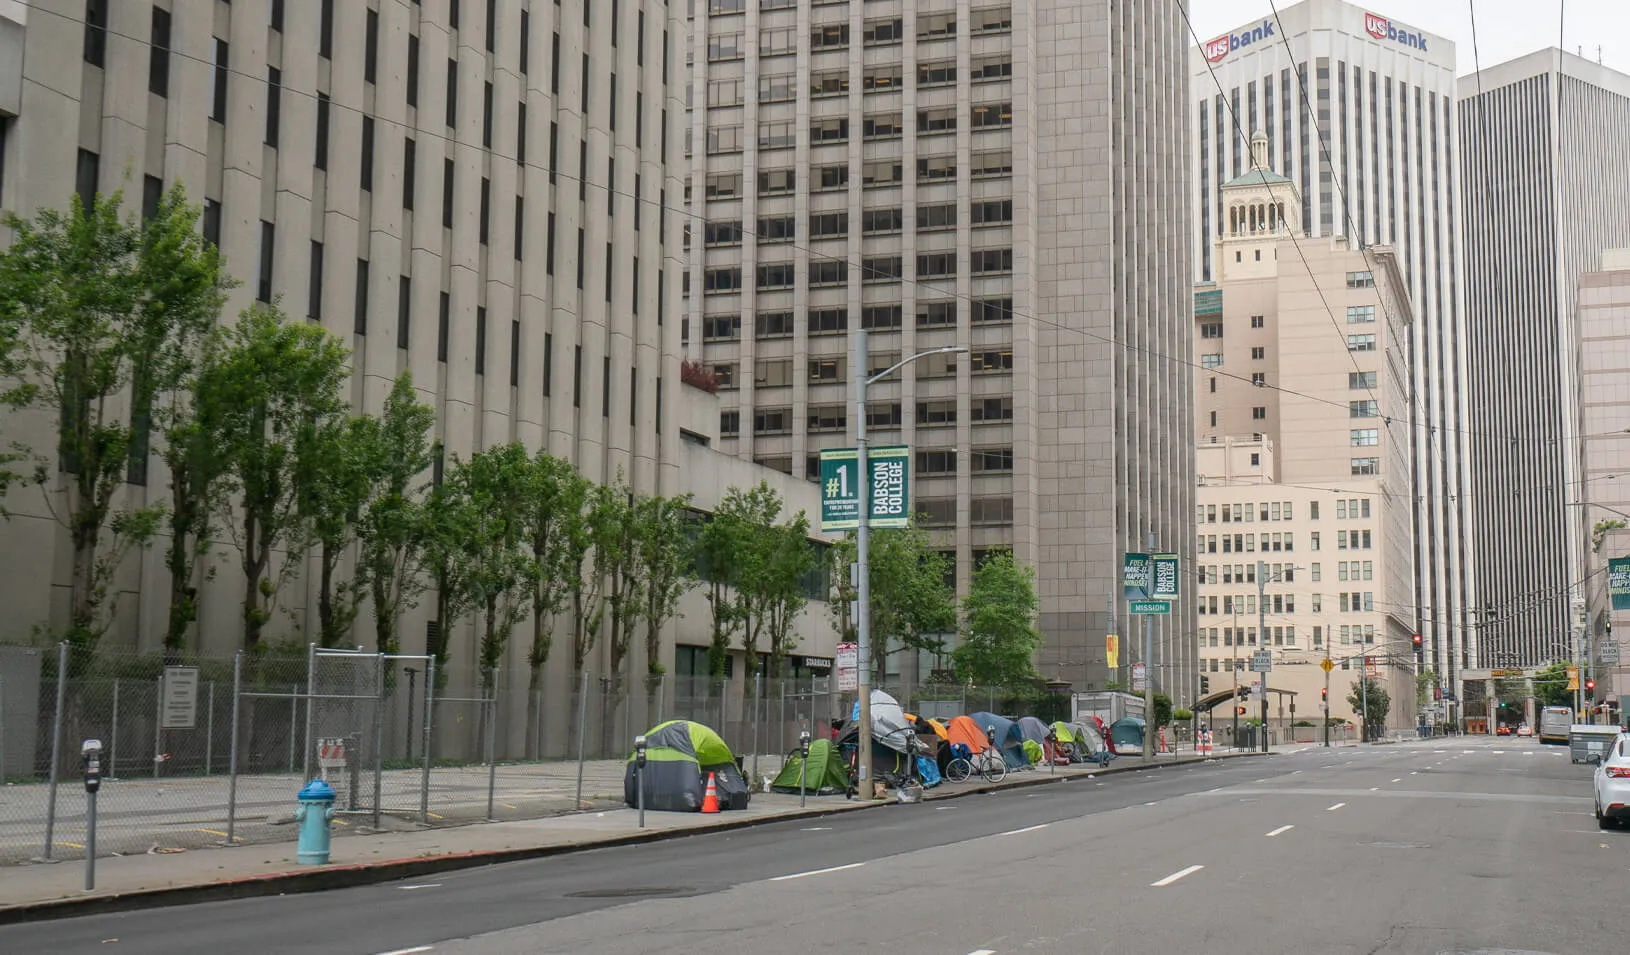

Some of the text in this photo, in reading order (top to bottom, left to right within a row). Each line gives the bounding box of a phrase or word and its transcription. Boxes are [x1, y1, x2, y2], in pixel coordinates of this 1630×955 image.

[873, 462, 889, 515] BABSON
[888, 461, 903, 514] COLLEGE
[1157, 561, 1167, 592] BABSON
[1166, 561, 1175, 592] COLLEGE
